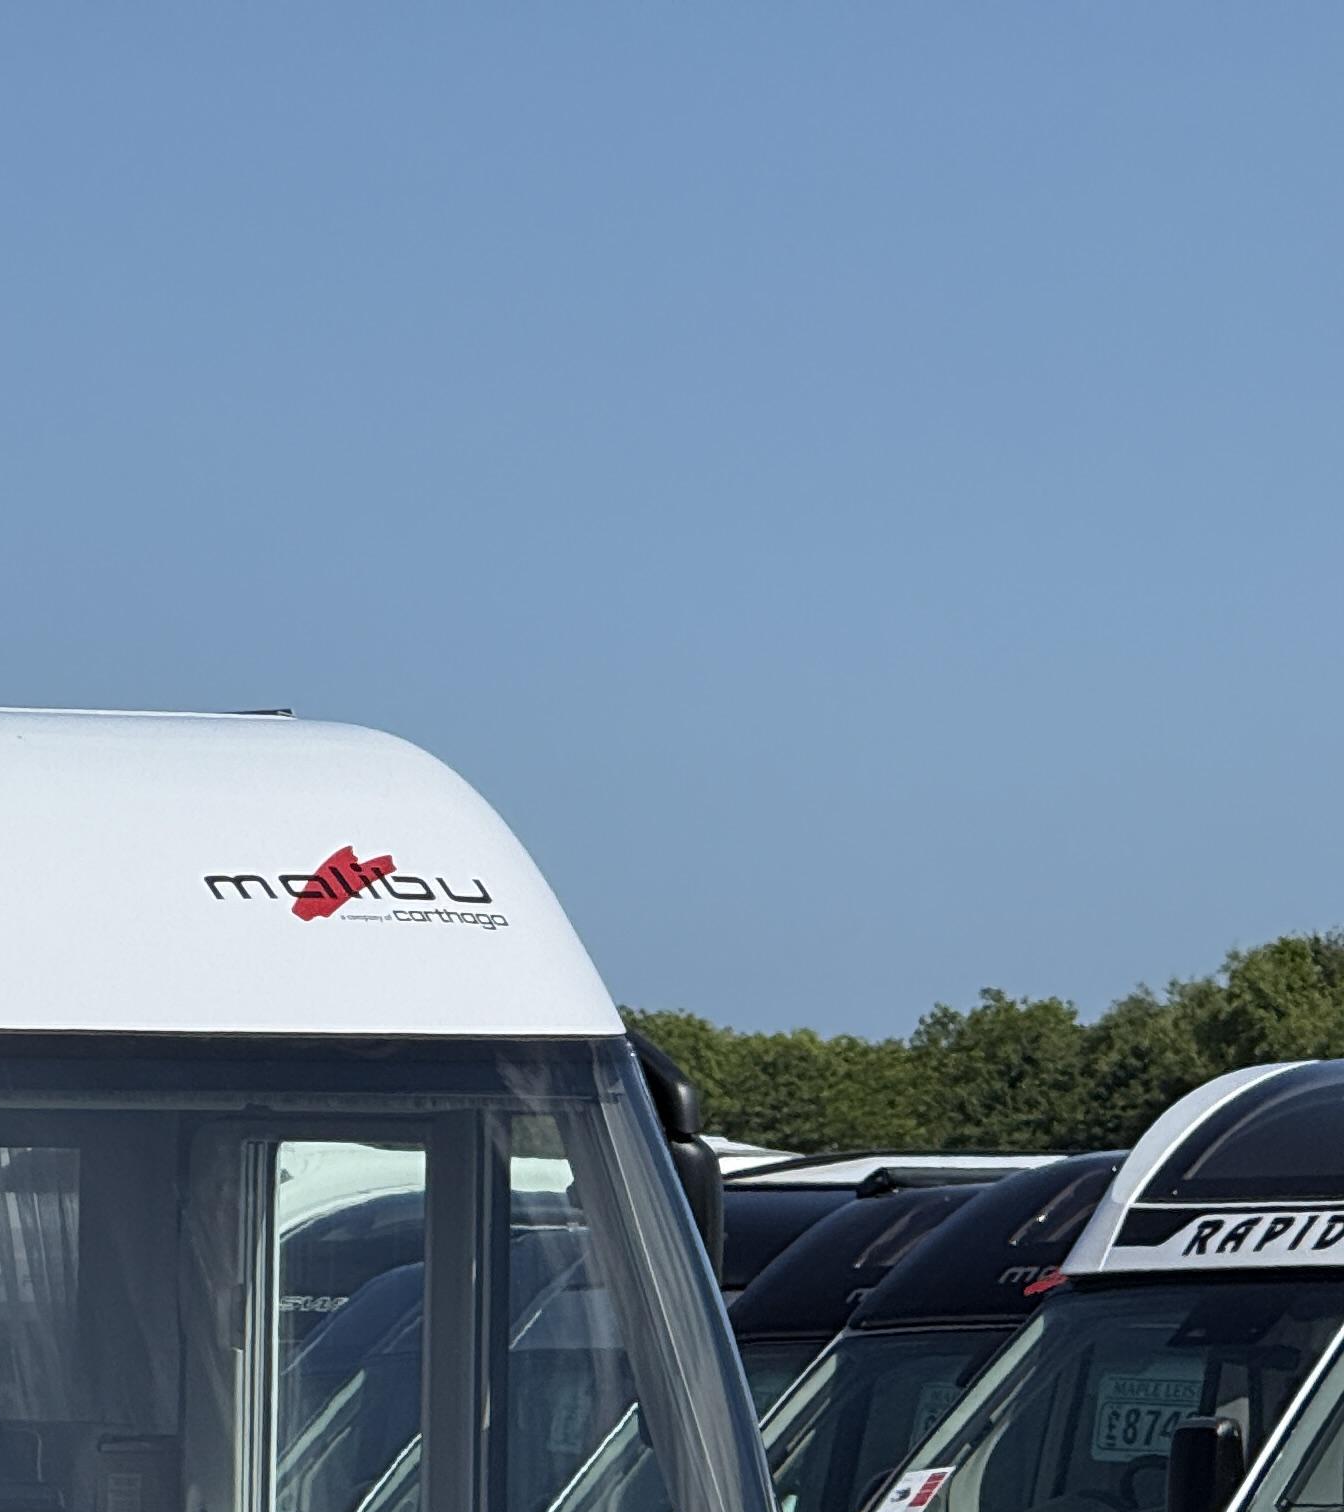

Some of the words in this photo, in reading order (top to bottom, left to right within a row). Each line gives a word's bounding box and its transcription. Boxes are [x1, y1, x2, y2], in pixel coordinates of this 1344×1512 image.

[204, 862, 493, 903] malibu
[393, 909, 509, 930] carthago
[1181, 1214, 1344, 1256] RAPID
